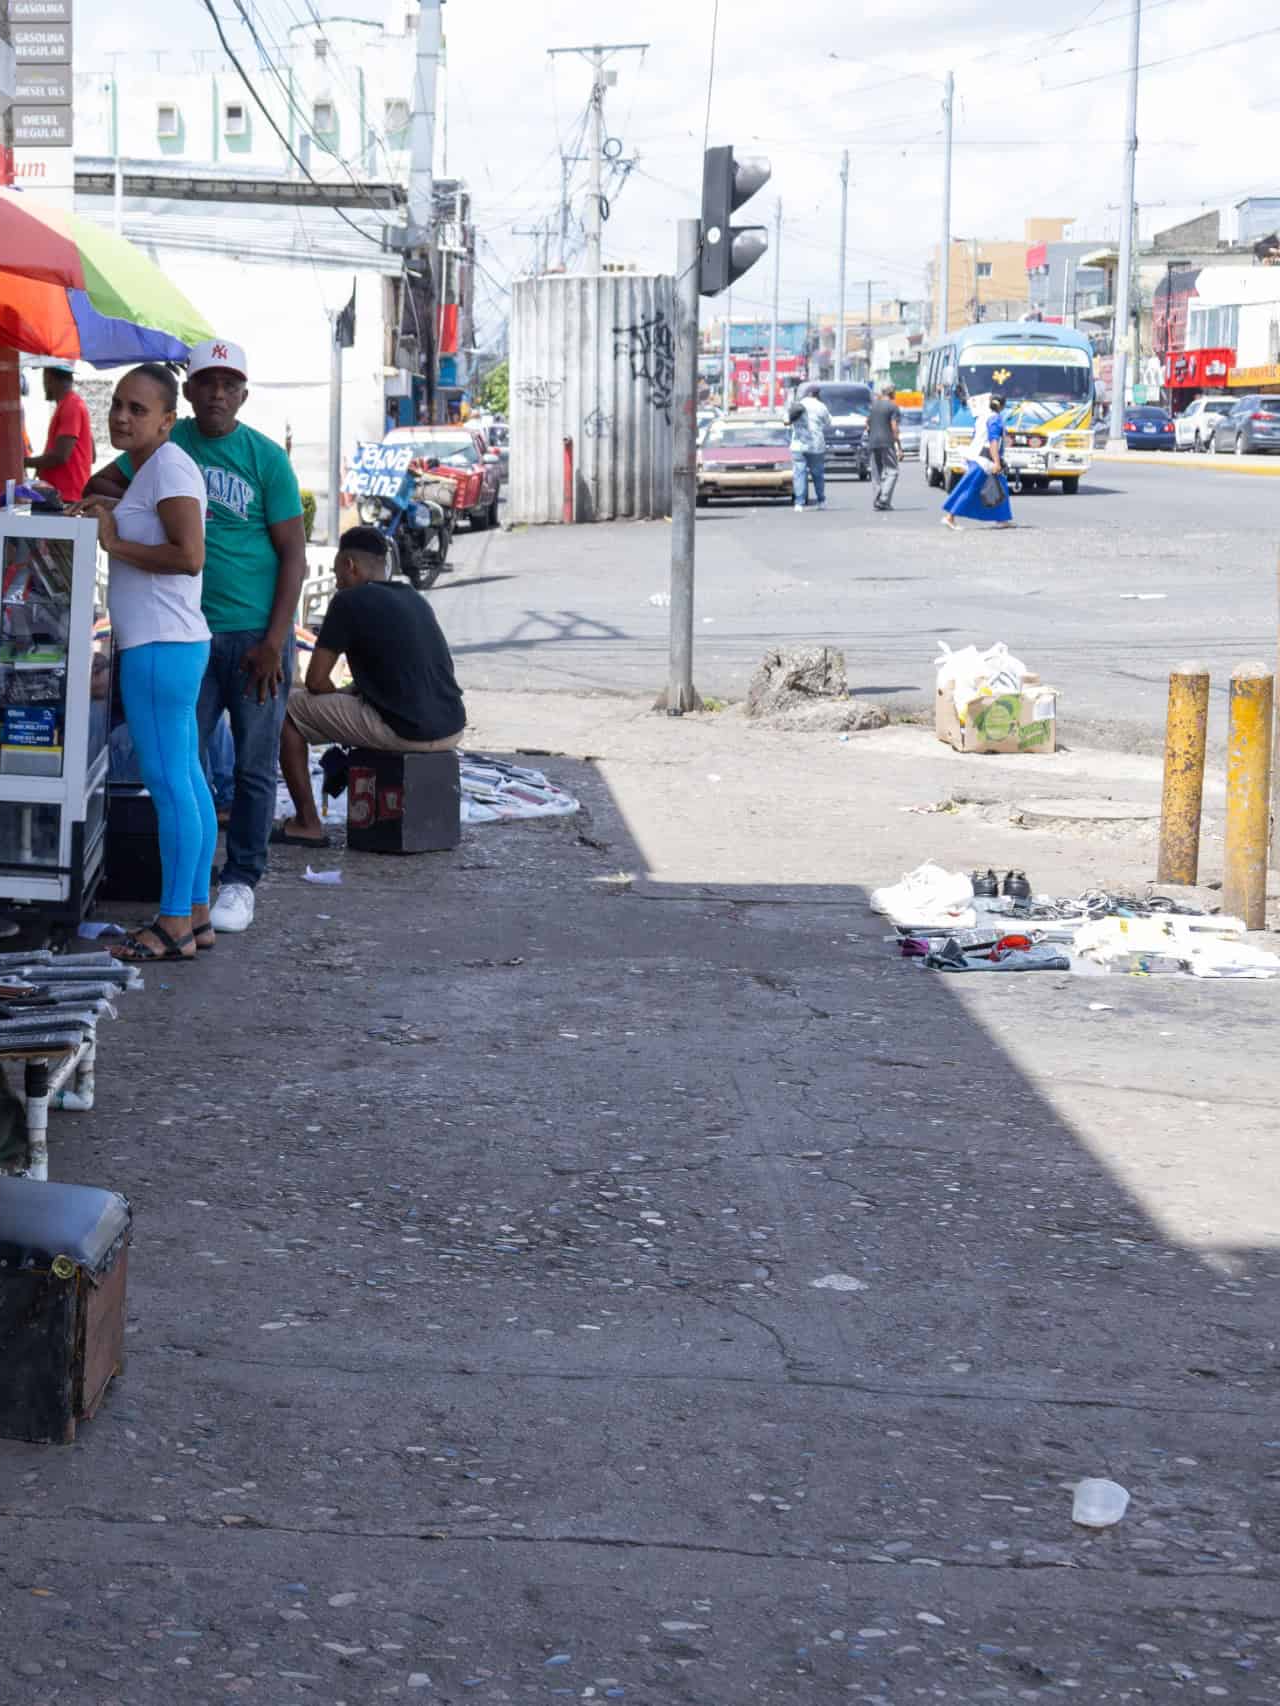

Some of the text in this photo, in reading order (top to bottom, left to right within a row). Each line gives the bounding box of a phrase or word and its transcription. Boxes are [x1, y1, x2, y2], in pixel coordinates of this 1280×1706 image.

[15, 3, 65, 13] GASOLINA
[15, 32, 65, 43] GASOLINA
[15, 45, 65, 56] REGULAR
[15, 86, 45, 96] DIESEL
[22, 114, 58, 125] DIESEL
[15, 128, 65, 138] REGULAR
